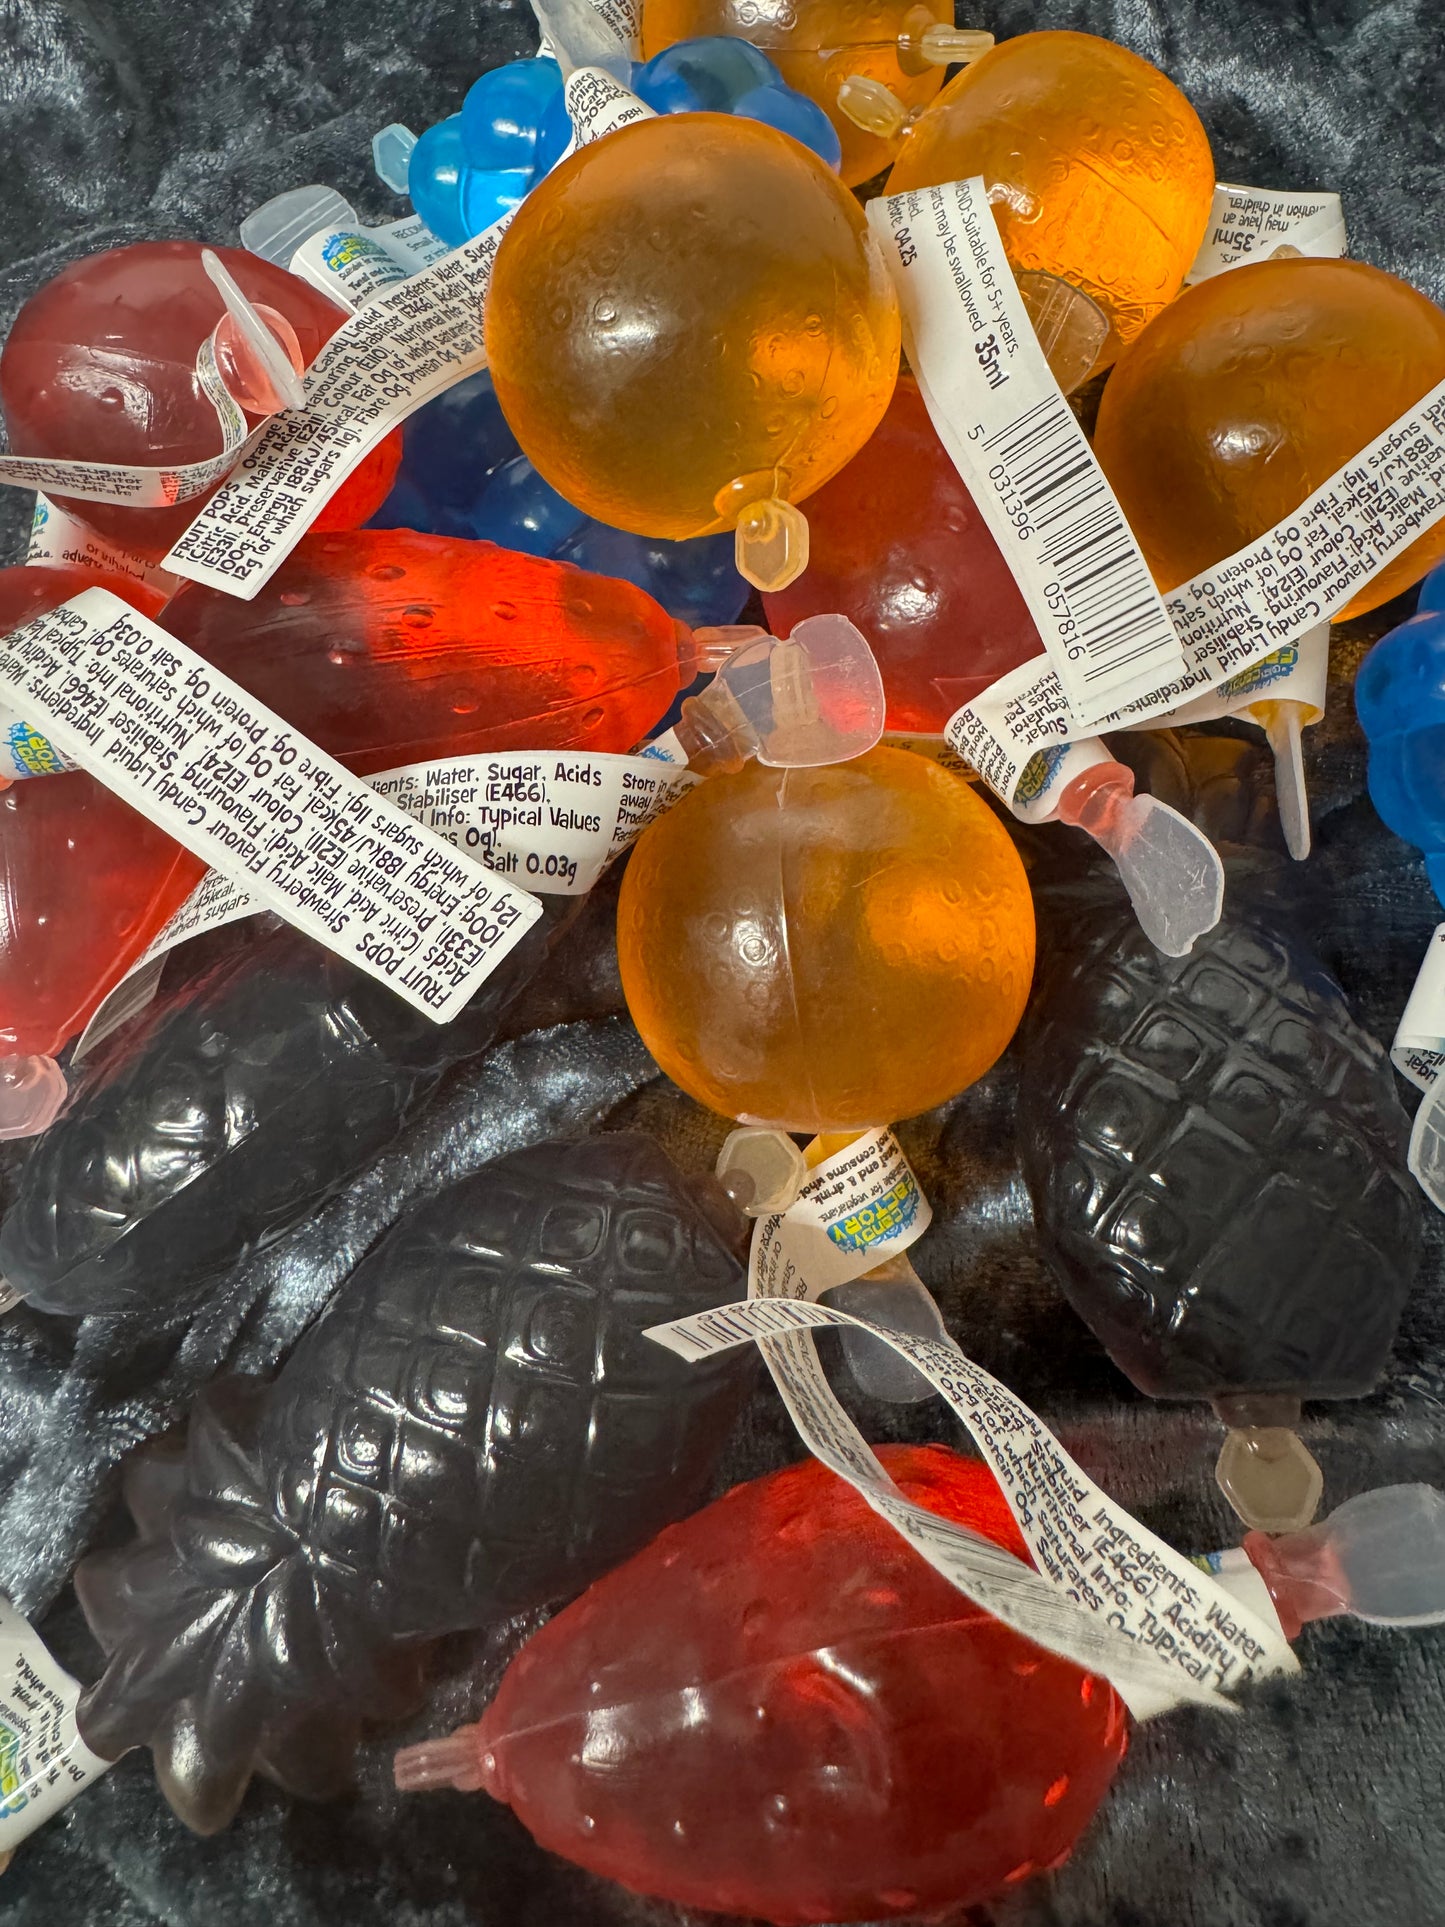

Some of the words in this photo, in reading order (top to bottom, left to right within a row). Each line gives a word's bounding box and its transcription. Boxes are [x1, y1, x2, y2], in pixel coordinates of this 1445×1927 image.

[935, 209, 951, 237] may
[1222, 213, 1236, 224] an
[1227, 197, 1270, 216] children.
[1236, 213, 1263, 233] have
[1264, 214, 1289, 232] may
[894, 227, 918, 267] 04.25
[943, 234, 957, 257] be
[963, 213, 990, 268] Suitable
[1212, 228, 1255, 252] 35ml
[948, 257, 988, 332] swallowed
[979, 266, 996, 289] for
[988, 289, 1004, 311] 5+
[992, 313, 1019, 358] years.
[974, 333, 1010, 390] 35ml
[171, 519, 209, 559] FRUIT
[203, 477, 240, 520] POPS
[241, 423, 286, 470] Orange
[312, 336, 356, 374] Candy
[343, 307, 384, 338] Liquid
[379, 276, 439, 311] Ingredients:
[235, 447, 302, 526] Preservative
[324, 371, 363, 408] Colour
[390, 311, 446, 347] Nutritional
[186, 525, 227, 563] (Citric
[245, 454, 279, 489] Malic
[351, 315, 404, 352] Stabiliser
[216, 539, 257, 575] 100g:
[247, 491, 293, 537] Energy
[352, 382, 378, 403] Fat
[404, 338, 438, 360] which
[1366, 420, 1421, 469] sugars
[231, 556, 264, 581] 12g
[253, 535, 274, 557] (of
[270, 495, 307, 535] which
[300, 449, 342, 494] sugars
[353, 396, 390, 426] Fibre
[402, 356, 443, 384] Protein
[1299, 491, 1340, 528] Fibre
[1384, 485, 1427, 522] Malic
[964, 419, 985, 440] 5
[987, 464, 1036, 541] 031396
[1043, 582, 1087, 661] 057816
[1303, 523, 1330, 549] Fat
[1372, 492, 1445, 556] rawberry
[1216, 547, 1273, 585] Protein
[1308, 524, 1355, 568] Colour
[1206, 578, 1254, 613] which
[1264, 554, 1348, 618] Flavouring,
[1321, 551, 1377, 603] Flavour
[107, 613, 154, 657] 0.03g
[1192, 614, 1264, 664] Stabiliser
[1265, 600, 1321, 640] Candy
[22, 644, 63, 678] Acidity
[38, 626, 87, 667] Typical
[148, 646, 183, 678] Salt
[1216, 632, 1268, 672] Liquid
[83, 656, 119, 692] Info:
[110, 648, 178, 703] saturates
[24, 674, 105, 747] Ingredients:
[1002, 702, 1026, 726] per
[1027, 682, 1064, 707] alues
[111, 680, 195, 750] Nutritional
[173, 694, 224, 739] which
[209, 691, 269, 745] Protein
[950, 708, 975, 738] Best
[967, 717, 983, 736] PO
[106, 709, 179, 771] Stabiliser
[215, 730, 247, 760] (of
[967, 725, 988, 760] World
[102, 737, 157, 788] Liquid
[244, 744, 275, 779] 0g
[296, 757, 343, 802] Fibre
[426, 767, 479, 787] Water,
[487, 763, 546, 781] Sugar,
[553, 762, 602, 786] Acids
[987, 752, 1008, 788] away
[999, 761, 1017, 796] Store
[152, 771, 207, 826] Candy
[178, 761, 268, 840] Flavouring,
[271, 771, 303, 803] Fat
[397, 787, 477, 811] Stabiliser
[618, 795, 655, 812] away
[621, 775, 656, 792] Store
[246, 786, 304, 836] Colour
[430, 805, 470, 827] Info:
[478, 806, 542, 831] Typical
[549, 807, 601, 832] Values
[204, 818, 270, 875] Flavour
[262, 827, 311, 871] Acid);
[370, 812, 425, 857] sugars
[305, 860, 347, 900] Malic
[418, 847, 469, 889] which
[483, 848, 519, 872] Salt
[525, 853, 578, 885] 0.03g
[202, 892, 250, 921] sugars
[265, 859, 351, 934] Strawberry
[342, 887, 382, 924] Acid,
[345, 858, 438, 933] Preservative
[403, 863, 462, 917] Energy
[462, 878, 492, 908] (of
[457, 902, 505, 949] 100g:
[489, 893, 524, 929] 12g
[355, 932, 405, 976] POPS
[377, 912, 424, 956] (Citric
[421, 945, 470, 988] Acids
[398, 964, 452, 1010] FRUIT
[825, 1145, 876, 1181] consume
[858, 1160, 880, 1182] end
[795, 1176, 826, 1202] whol
[809, 1181, 845, 1206] drink.
[968, 1410, 1016, 1487] Protein
[1034, 1535, 1064, 1584] Salt
[991, 1384, 1042, 1438] Candy
[1043, 1439, 1090, 1504] Liquid
[1092, 1507, 1202, 1611] Ingredients:
[1003, 1440, 1039, 1506] which
[1036, 1509, 1105, 1612] saturates
[1022, 1450, 1093, 1565] Nutritional
[1089, 1563, 1134, 1613] Info:
[1136, 1607, 1213, 1685] Typical
[1030, 1438, 1092, 1534] Stabiliser
[1161, 1599, 1243, 1682] Acidity
[66, 1764, 86, 1782] Do
